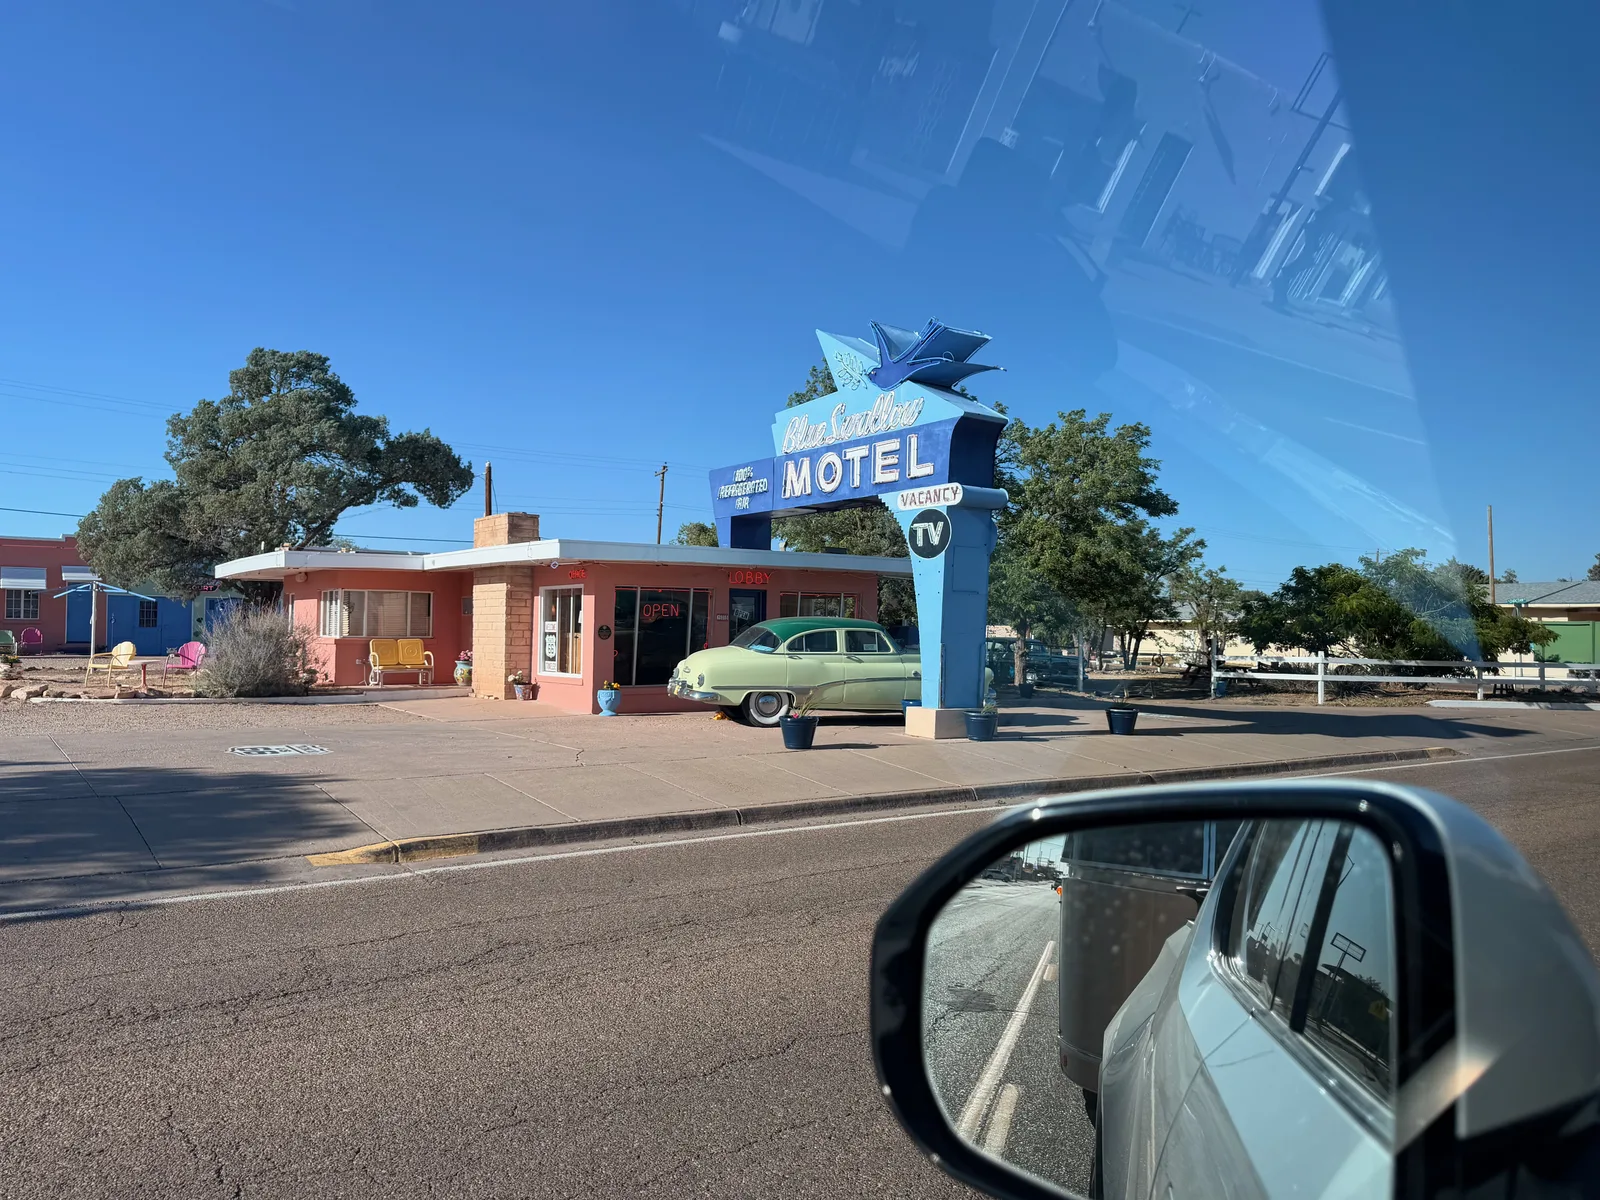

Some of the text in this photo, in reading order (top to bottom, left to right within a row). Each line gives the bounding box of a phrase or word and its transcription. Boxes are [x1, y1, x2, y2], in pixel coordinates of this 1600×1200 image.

[782, 391, 925, 454] Blue Swallow
[781, 433, 934, 499] MOTEL
[901, 485, 959, 507] VACANCY
[911, 521, 944, 547] TV
[729, 570, 770, 584] LOBBY
[643, 604, 679, 616] OPEN
